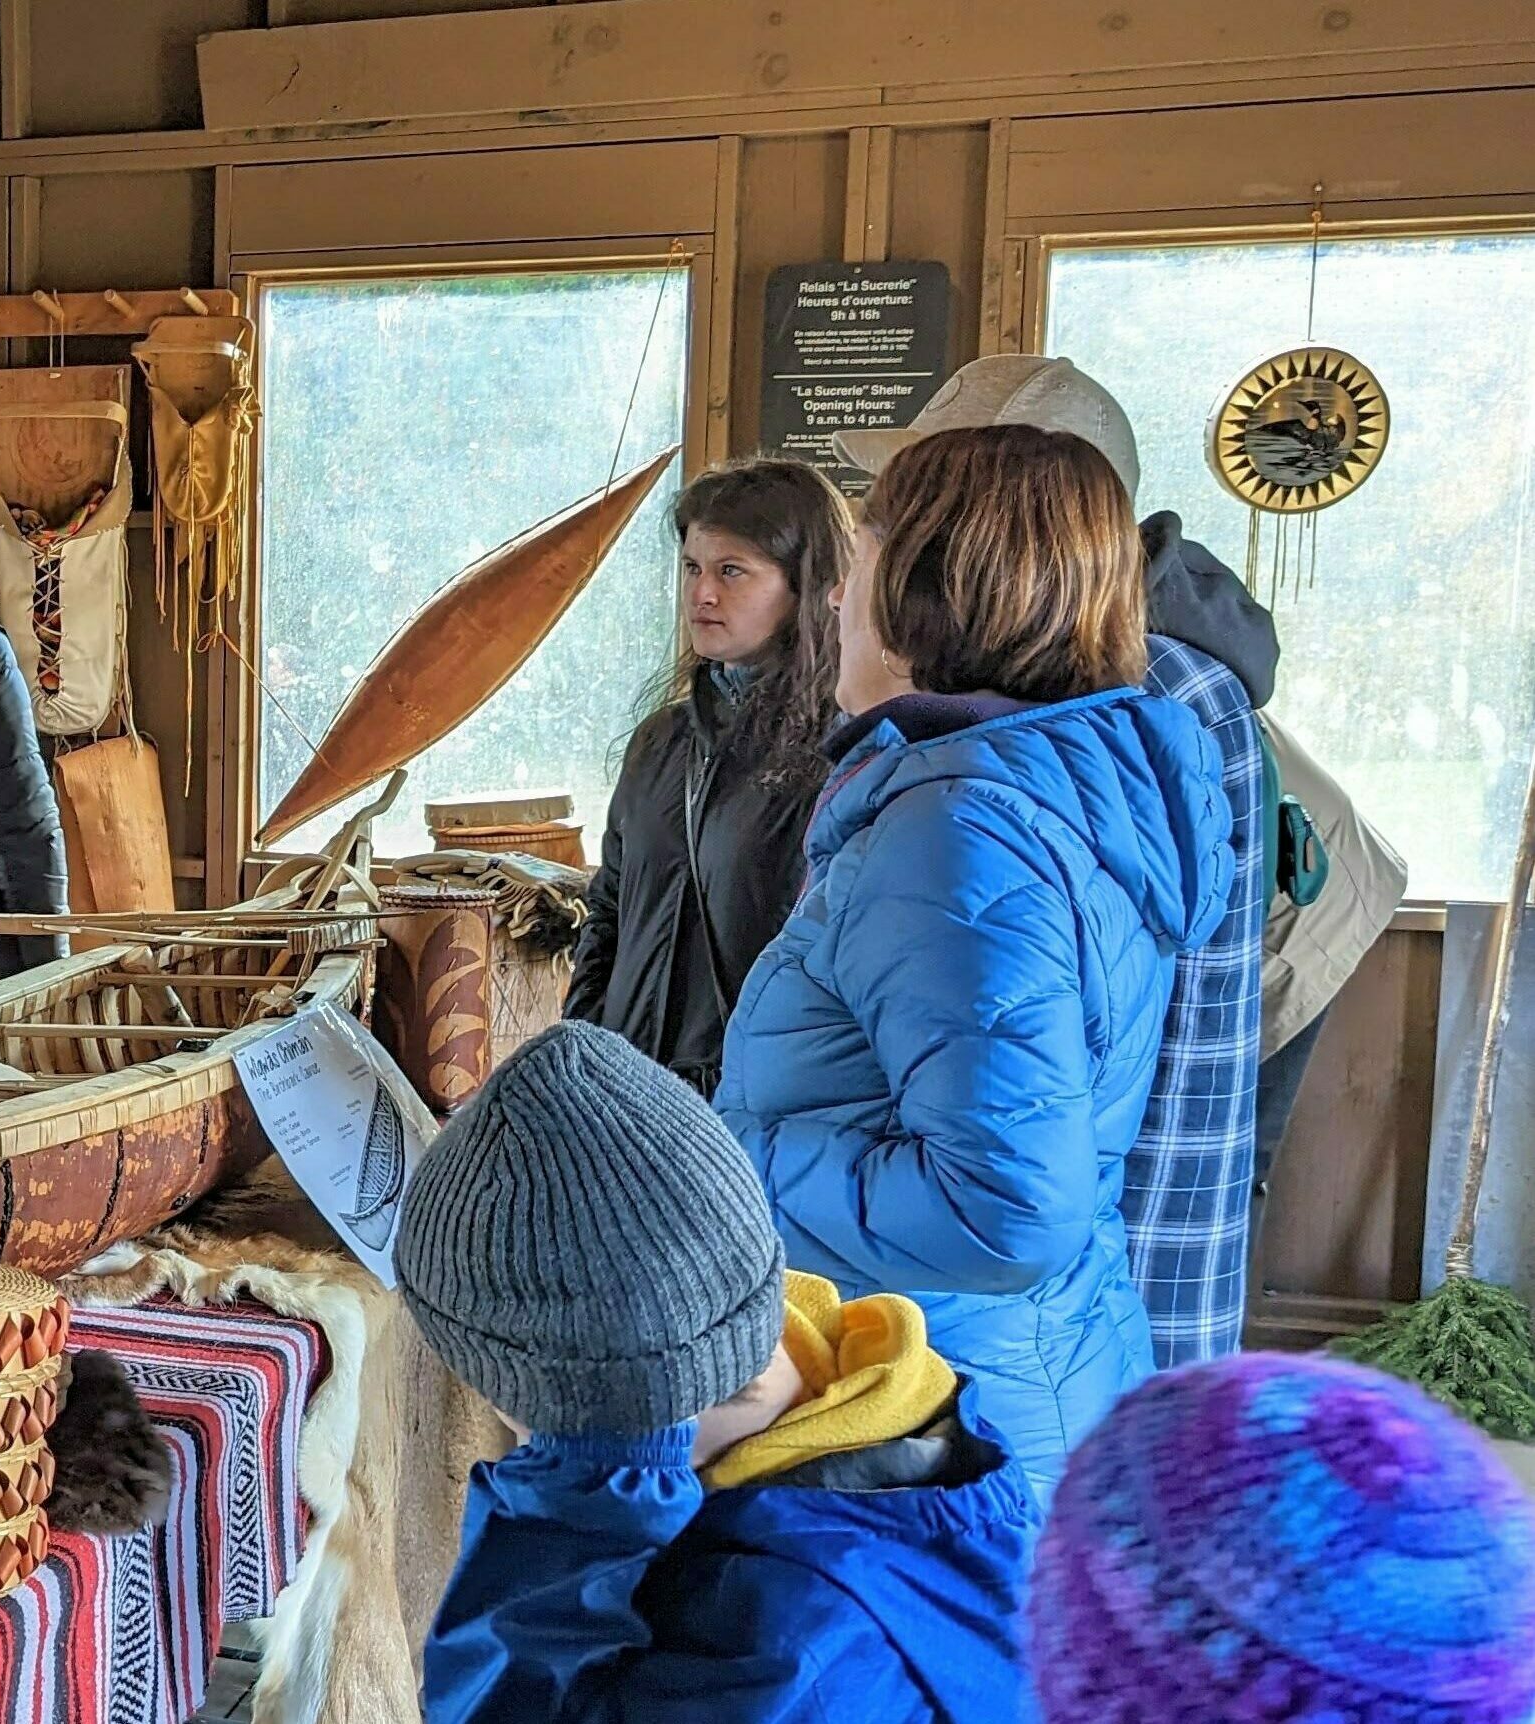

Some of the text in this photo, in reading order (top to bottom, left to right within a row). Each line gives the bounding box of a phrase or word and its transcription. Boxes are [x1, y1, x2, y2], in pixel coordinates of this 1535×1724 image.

[799, 281, 836, 293] Relais
[861, 278, 918, 291] Sucrerie”
[797, 295, 914, 308] Heures d’ouverture:
[830, 308, 881, 321] 9h à 16h
[814, 385, 870, 396] Sucrerie”
[870, 383, 914, 396] Shelter
[803, 399, 896, 413] Opening Hours:
[806, 414, 894, 427] 9 a.m. to 4 p.m.
